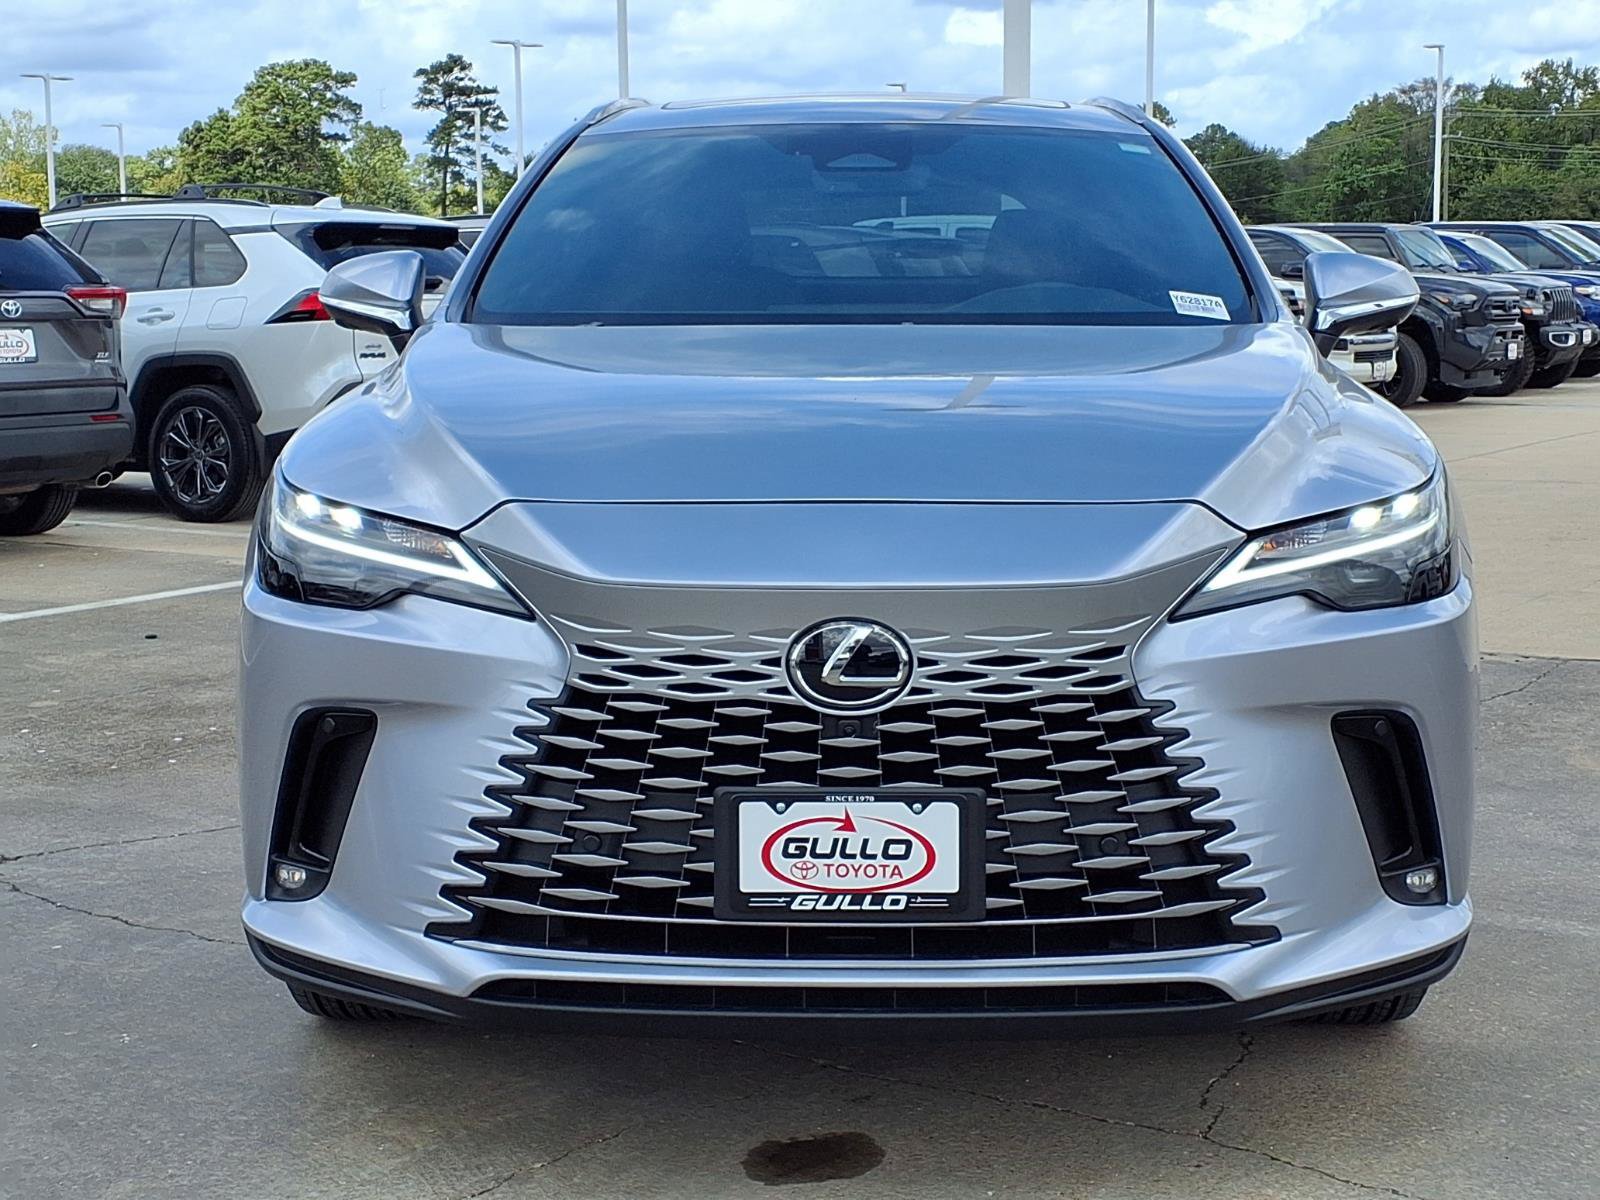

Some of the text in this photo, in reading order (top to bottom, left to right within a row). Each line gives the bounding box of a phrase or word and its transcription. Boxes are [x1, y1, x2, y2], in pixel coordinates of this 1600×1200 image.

[781, 837, 913, 861] GULLO
[823, 864, 903, 879] TOYOTA
[790, 894, 907, 911] GULLO
